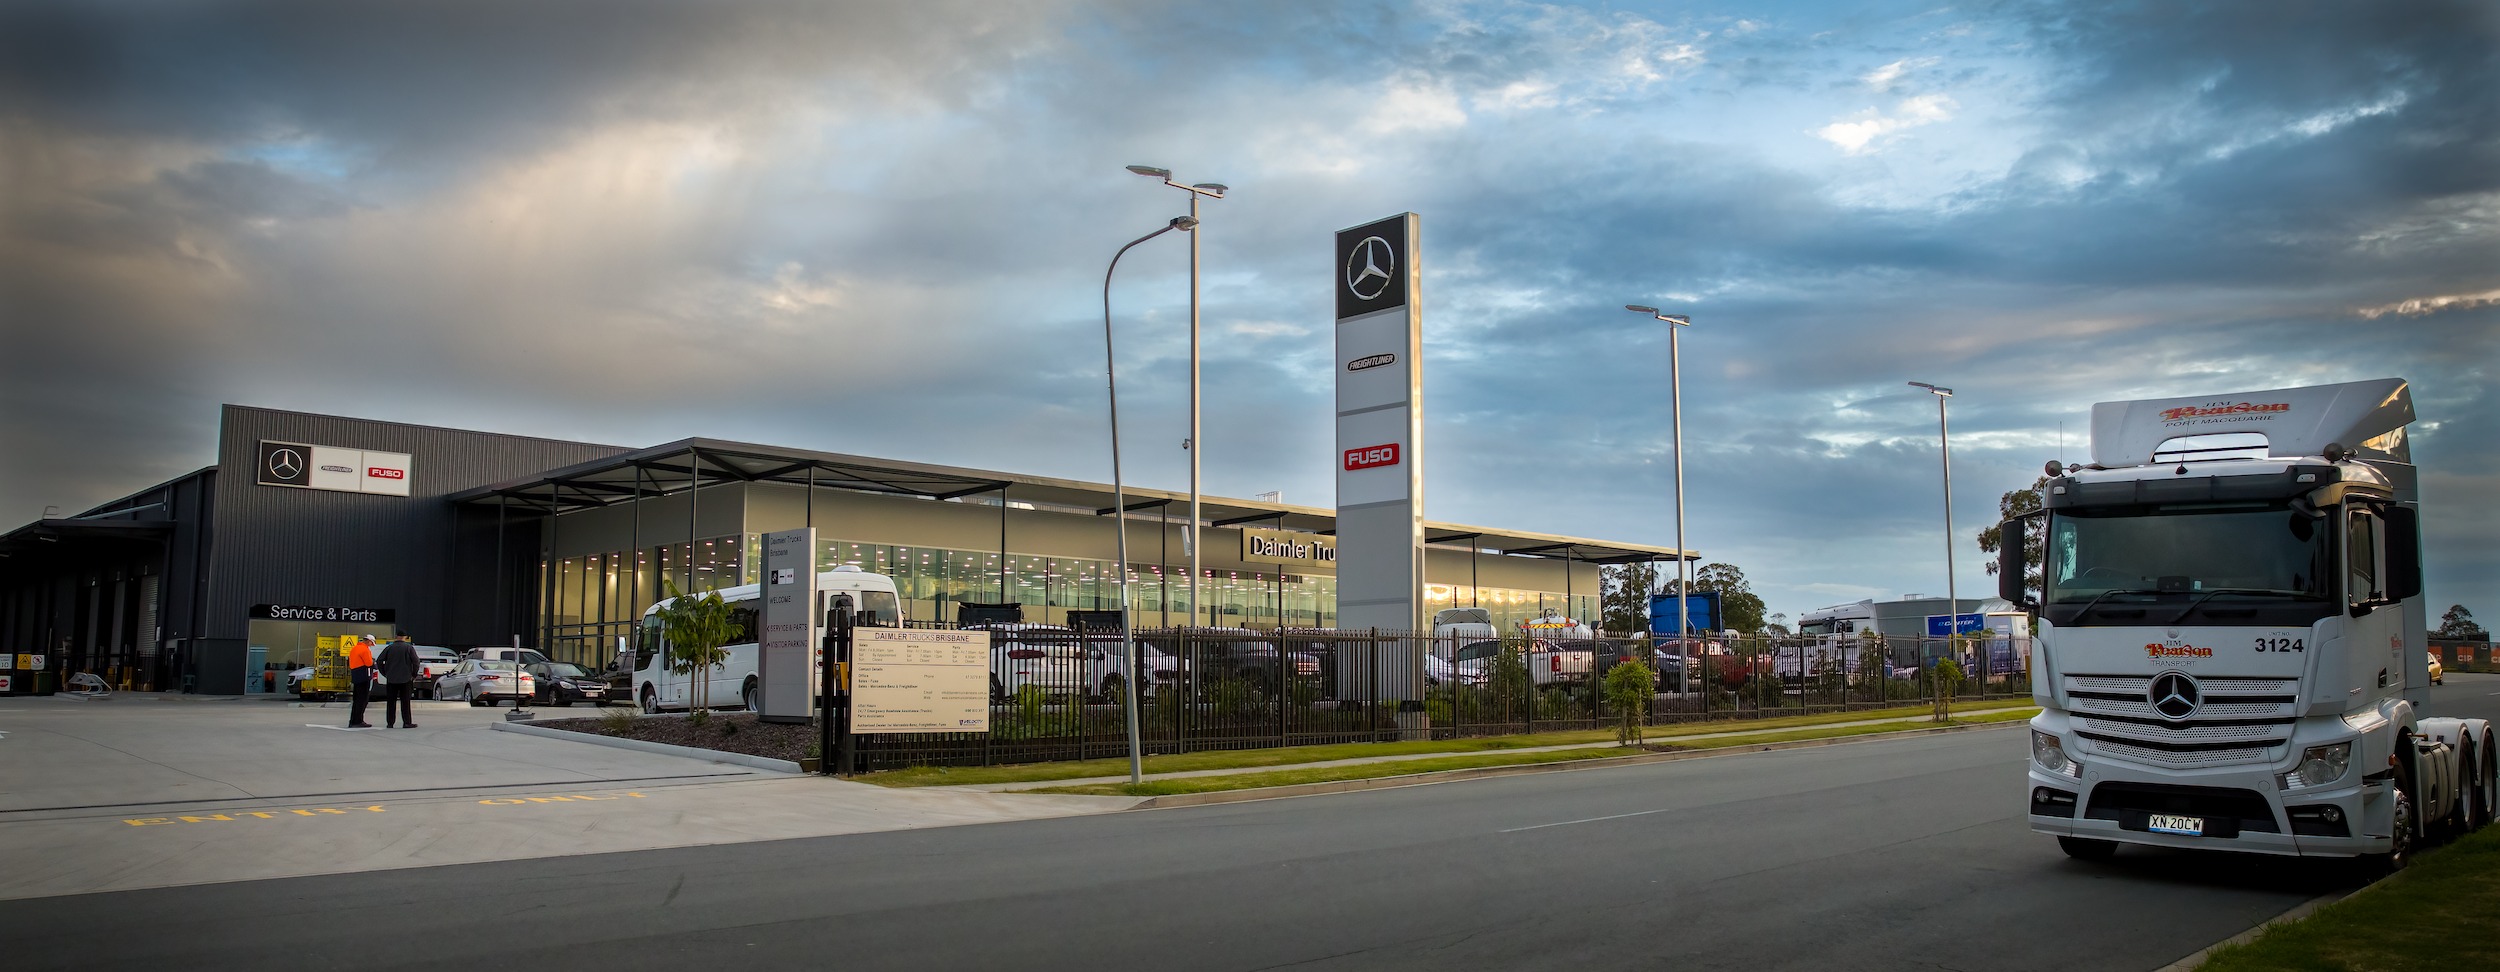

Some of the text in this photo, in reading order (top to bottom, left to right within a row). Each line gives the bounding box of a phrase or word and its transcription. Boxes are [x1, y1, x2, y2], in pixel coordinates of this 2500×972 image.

[1350, 354, 1394, 370] FREIGHTLINER
[2159, 402, 2290, 422] Pearson
[2165, 415, 2275, 428] PORT MACQUARIE
[1348, 448, 1393, 466] FUSO
[372, 470, 401, 478] FUSO
[1253, 536, 1310, 559] Daimler
[770, 596, 791, 604] WELCOME
[270, 604, 377, 622] Service & Parts
[788, 640, 808, 648] PARKING
[874, 632, 970, 642] DAIMLER TRUCKS BRISBANE
[2254, 638, 2304, 652] 3124
[2144, 642, 2213, 659] Pearson
[122, 792, 648, 826] ENTRY ONLY
